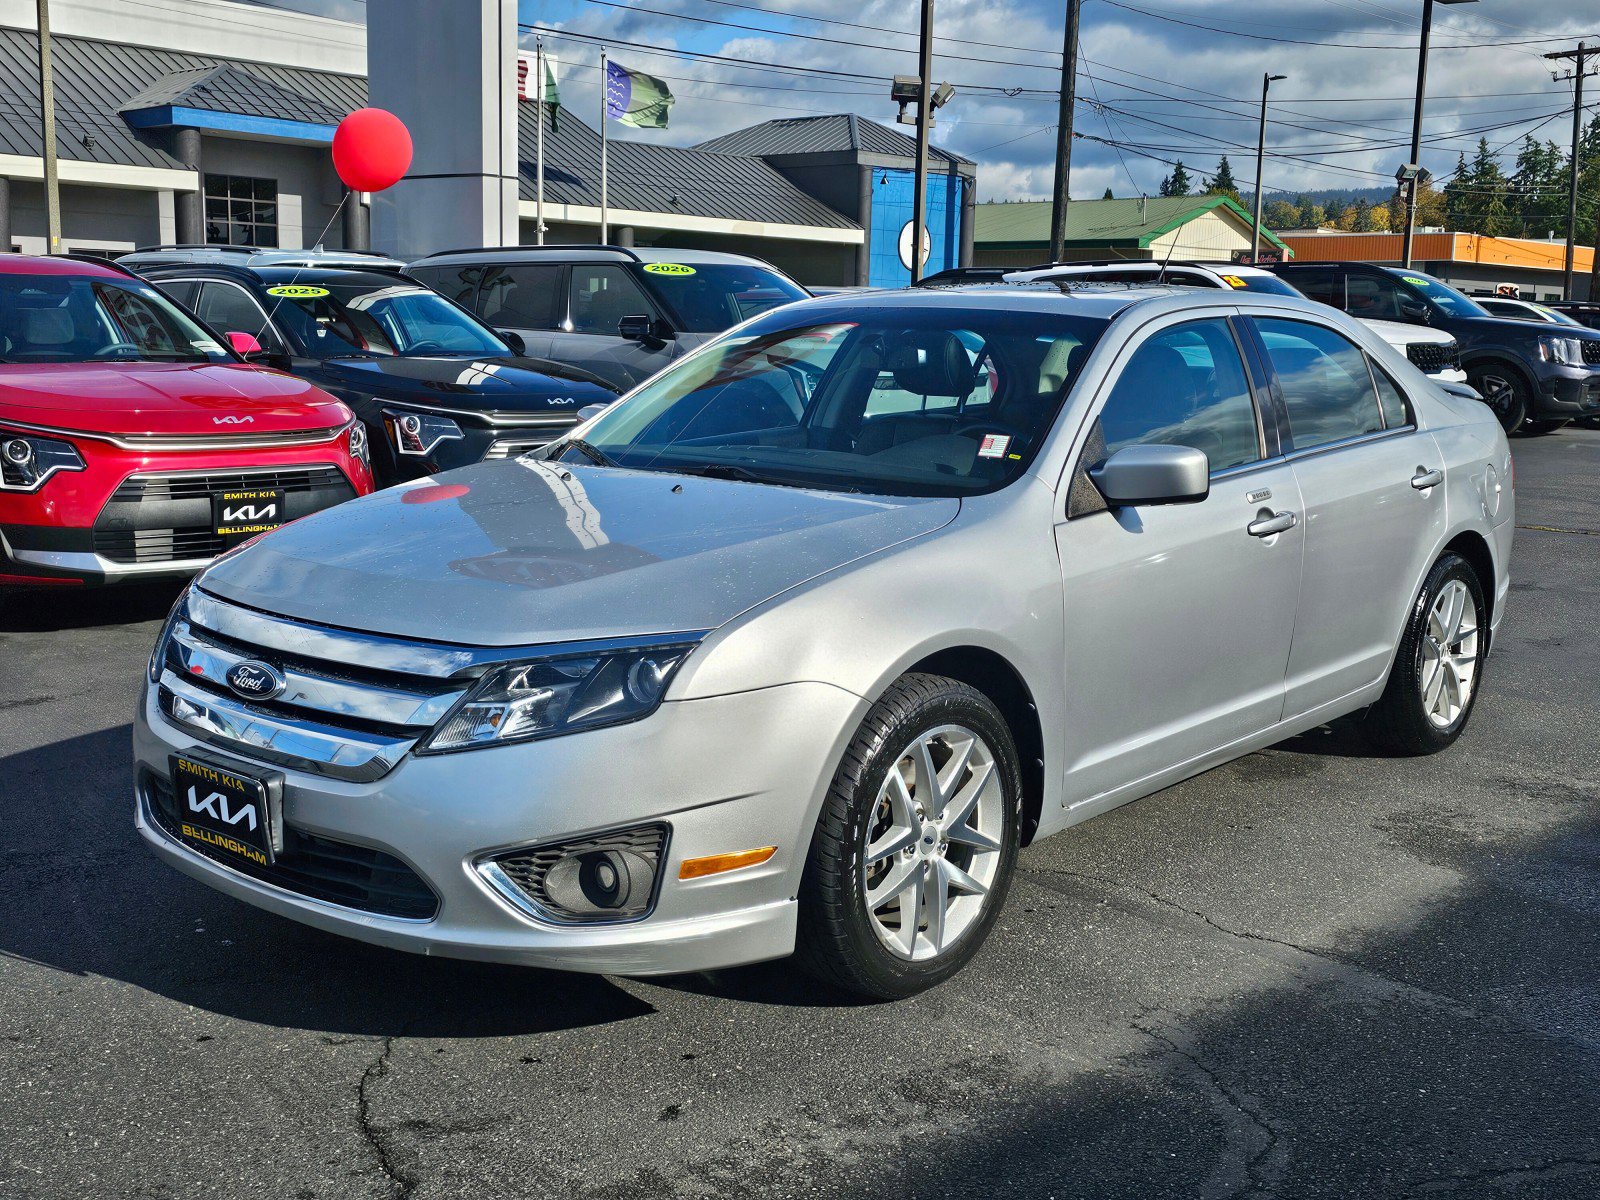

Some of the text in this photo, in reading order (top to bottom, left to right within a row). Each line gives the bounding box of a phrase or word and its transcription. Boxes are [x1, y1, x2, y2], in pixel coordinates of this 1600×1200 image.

[223, 490, 277, 500] SMITH KIA
[233, 666, 265, 690] Ford
[178, 759, 246, 792] SMITH KIA
[181, 824, 268, 866] BELLINGHAM
